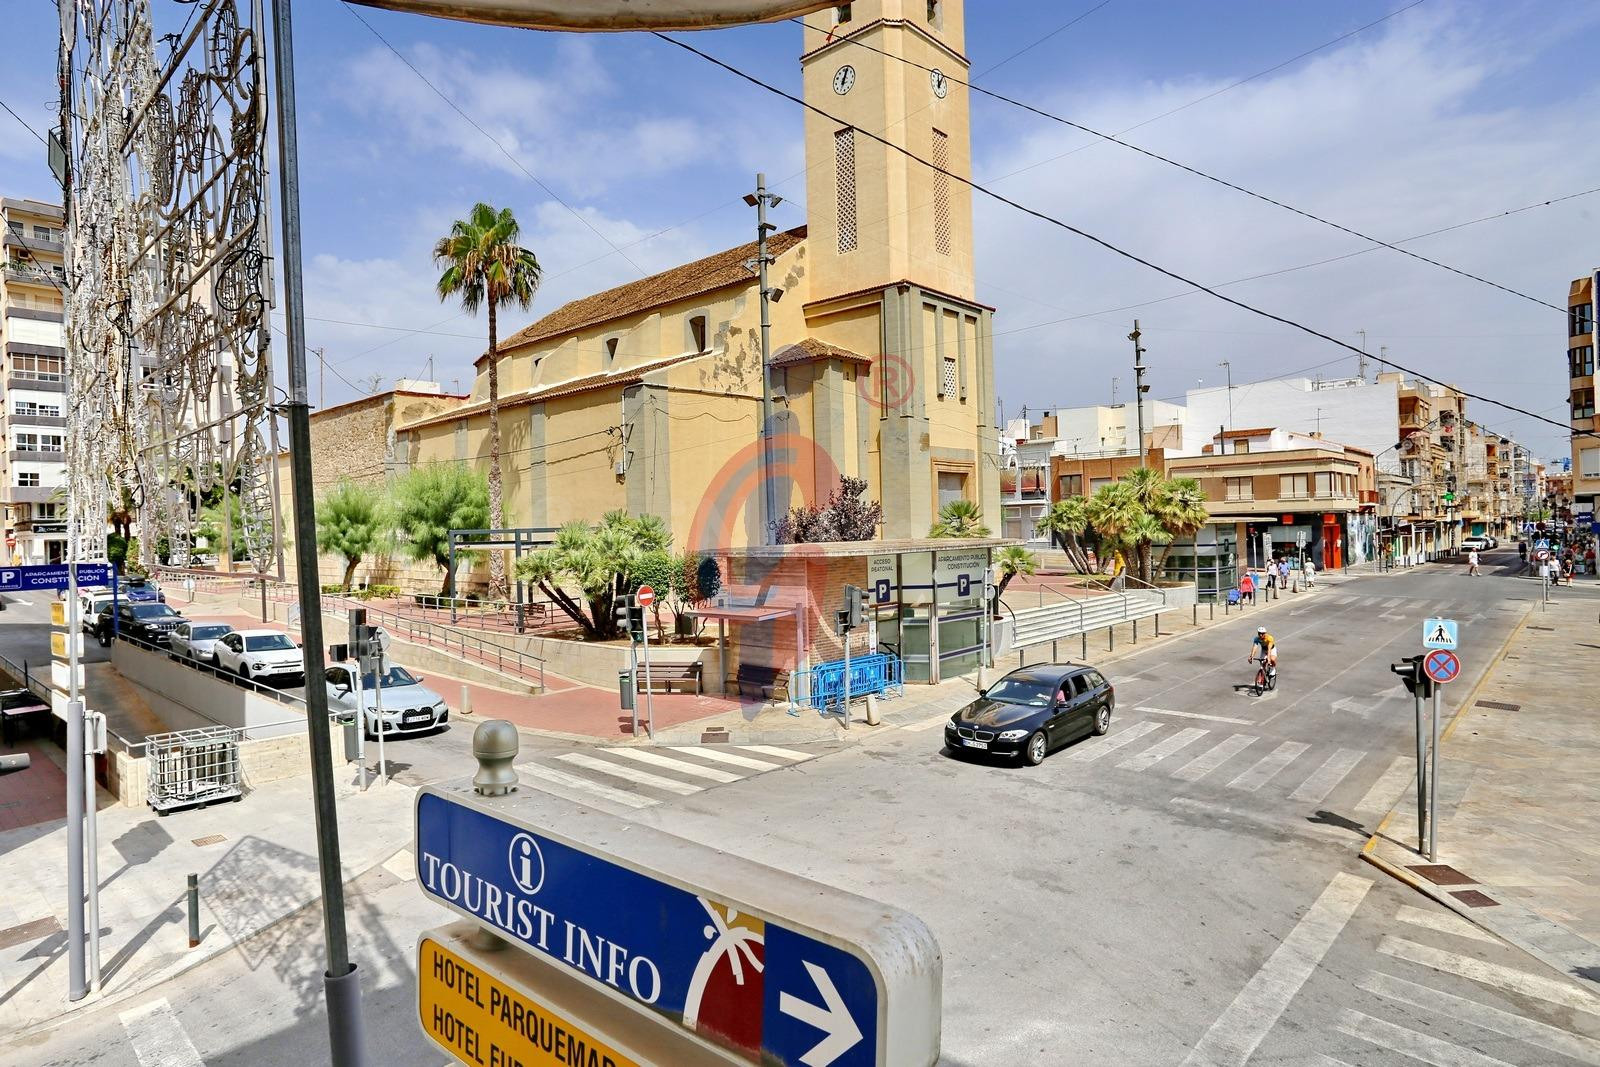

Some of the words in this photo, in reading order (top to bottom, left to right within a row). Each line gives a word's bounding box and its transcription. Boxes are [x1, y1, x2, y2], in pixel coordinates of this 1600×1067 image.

[2, 572, 15, 584] P
[31, 575, 100, 585] CONSTITCIÓN
[960, 578, 967, 592] P
[879, 584, 887, 598] P
[424, 852, 555, 951] TOURIST
[564, 919, 661, 1004] INFO
[434, 951, 484, 1009] HOTEL
[434, 1003, 484, 1066] HOTEL
